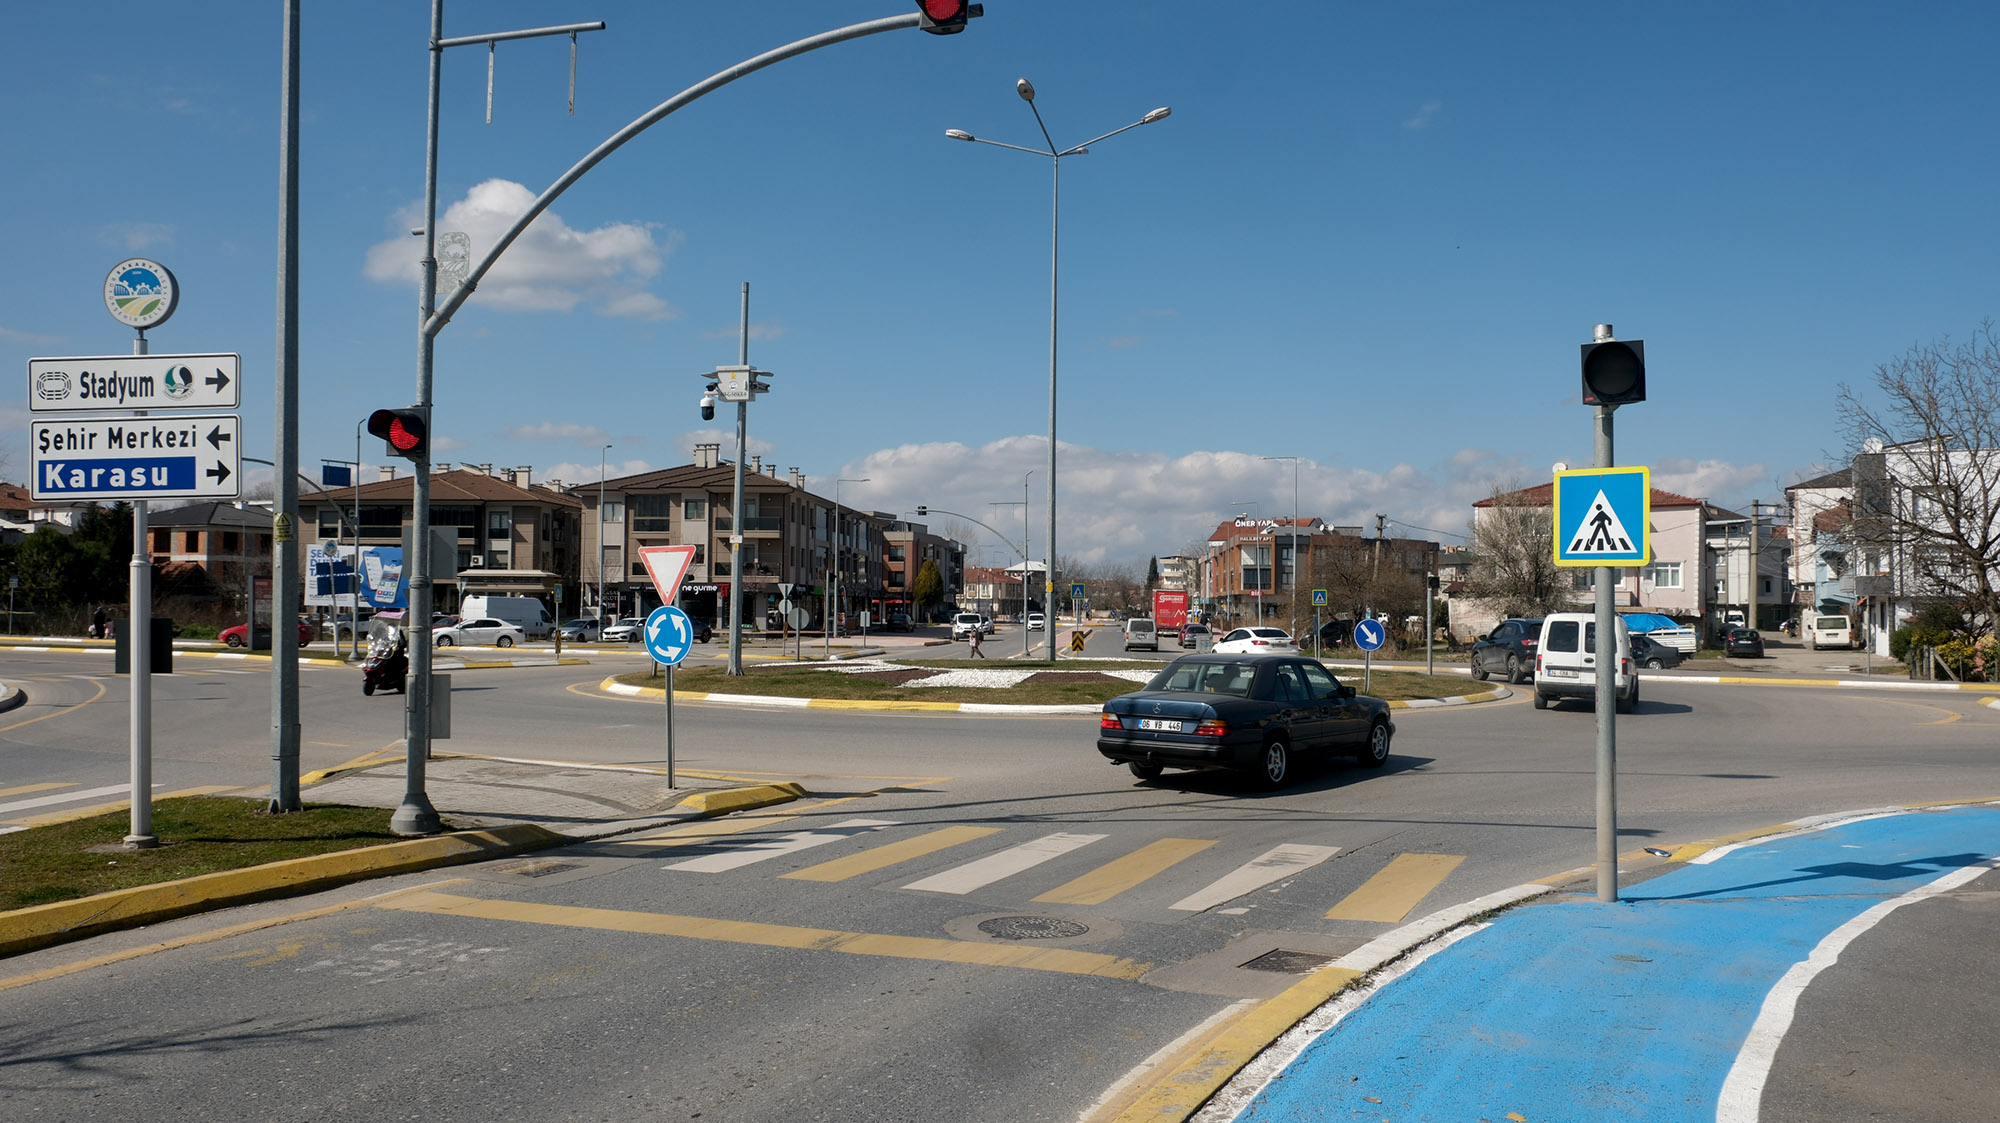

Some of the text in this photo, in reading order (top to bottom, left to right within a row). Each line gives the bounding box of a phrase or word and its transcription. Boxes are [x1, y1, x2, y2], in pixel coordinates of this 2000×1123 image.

[116, 262, 159, 275] SAKARYA
[79, 370, 155, 405] Stadyum
[38, 424, 197, 454] Şehir Merkezi
[45, 462, 169, 489] Karasu
[1235, 519, 1256, 528] ÖNER
[692, 585, 718, 595] gurme
[1142, 720, 1151, 729] 06
[1168, 721, 1181, 731] 446
